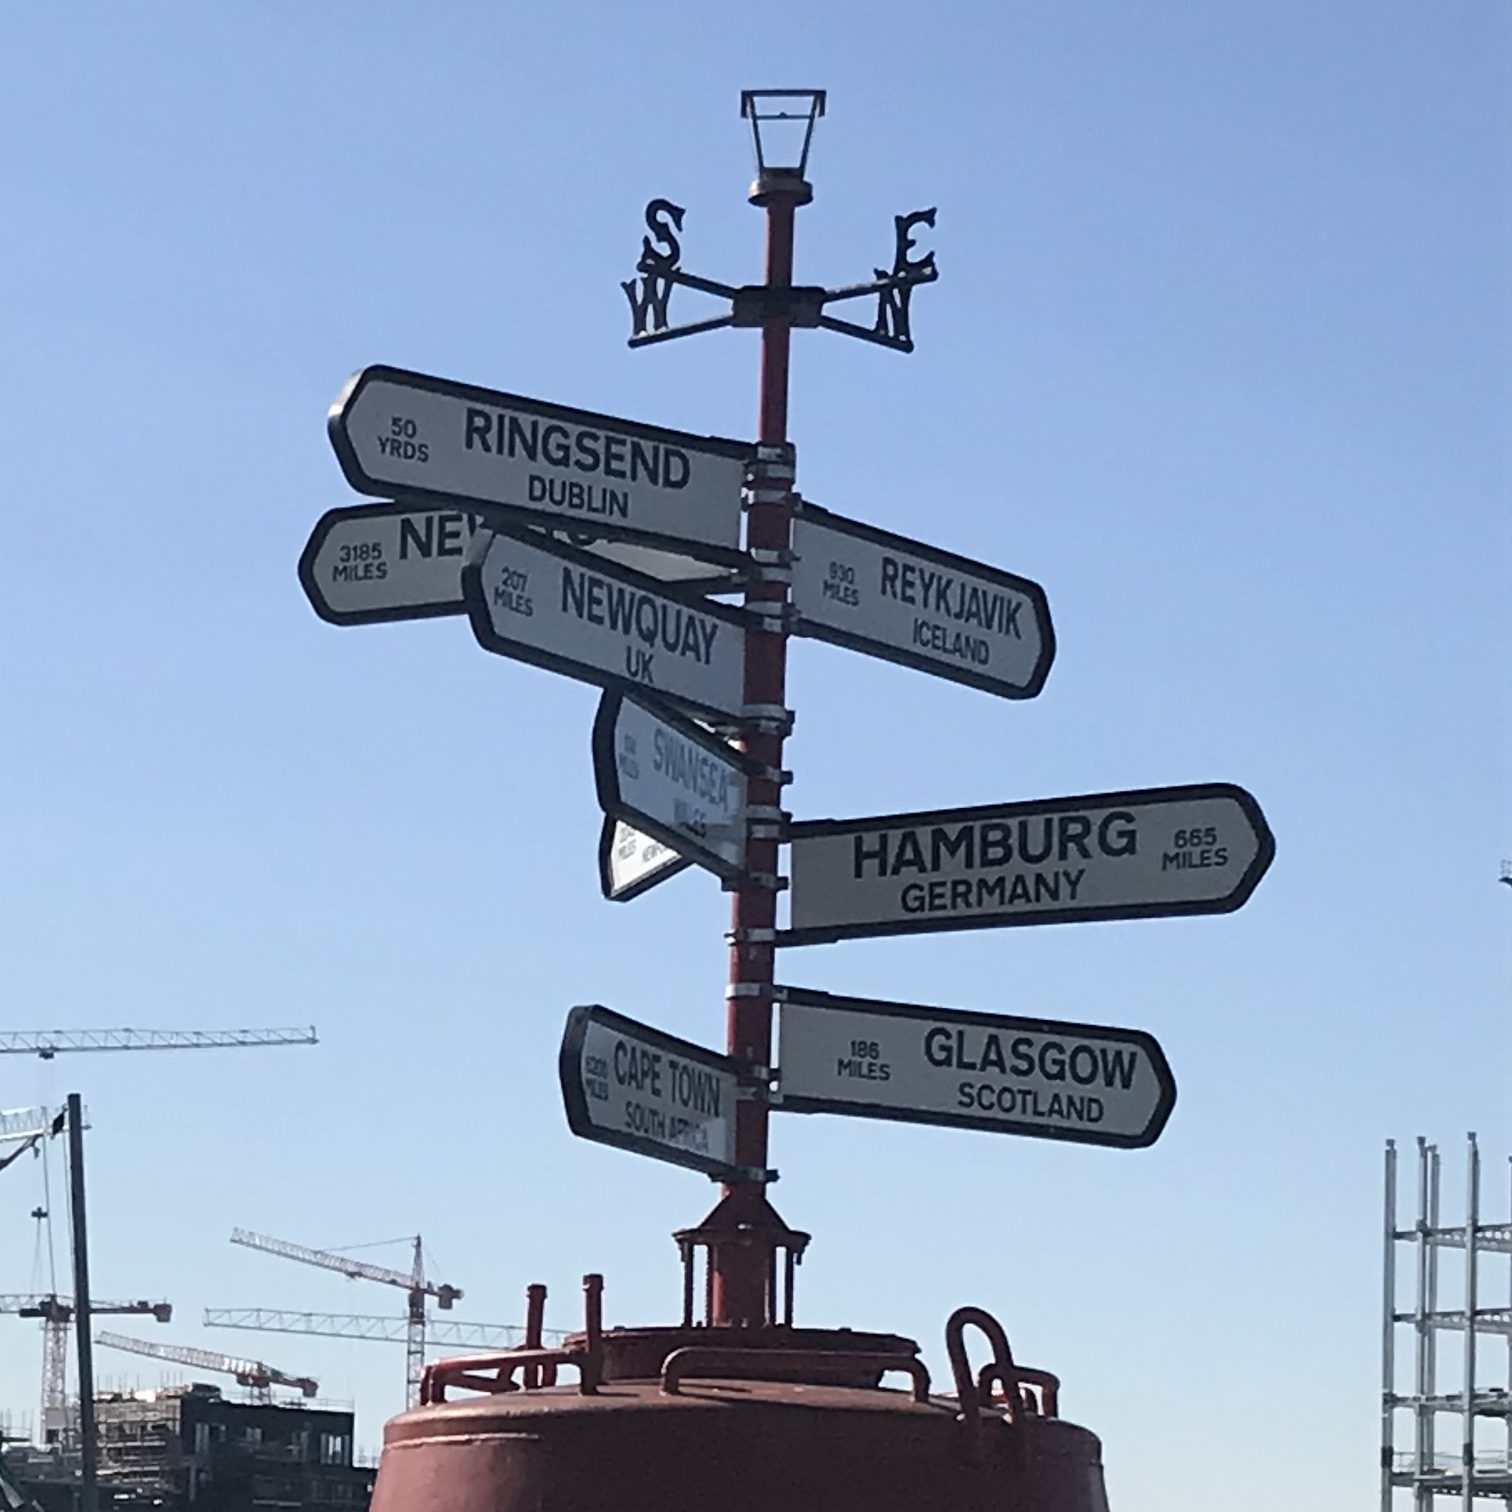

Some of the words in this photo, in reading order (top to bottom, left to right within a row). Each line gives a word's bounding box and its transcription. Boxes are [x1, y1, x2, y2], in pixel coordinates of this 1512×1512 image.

[637, 199, 685, 270] S
[894, 207, 938, 276] E
[391, 416, 416, 439] 50
[377, 435, 429, 463] YRDS
[464, 407, 690, 490] RINGSEND
[528, 474, 629, 518] DUBLIN
[332, 560, 387, 582] MILES
[339, 543, 382, 562] 3185
[501, 566, 527, 592] 207
[822, 580, 859, 607] MILES
[881, 556, 1022, 640] REYKJAVIK
[494, 590, 533, 617] MILES
[561, 566, 718, 665] NEWQUAY
[913, 618, 990, 666] ICELAND
[625, 646, 654, 683] UK
[853, 811, 1137, 879] HAMBURG
[1174, 827, 1218, 848] 665
[1162, 847, 1229, 871] MILES
[901, 868, 1086, 914] GERMANY
[850, 1040, 880, 1060] 186
[924, 1027, 1137, 1090] GLASGOW
[614, 1039, 663, 1098] CAPE
[668, 1059, 721, 1119] TOWN
[837, 1059, 891, 1081] MILES
[625, 1100, 667, 1139] SOUTH
[958, 1082, 1104, 1124] SCOTLAND
